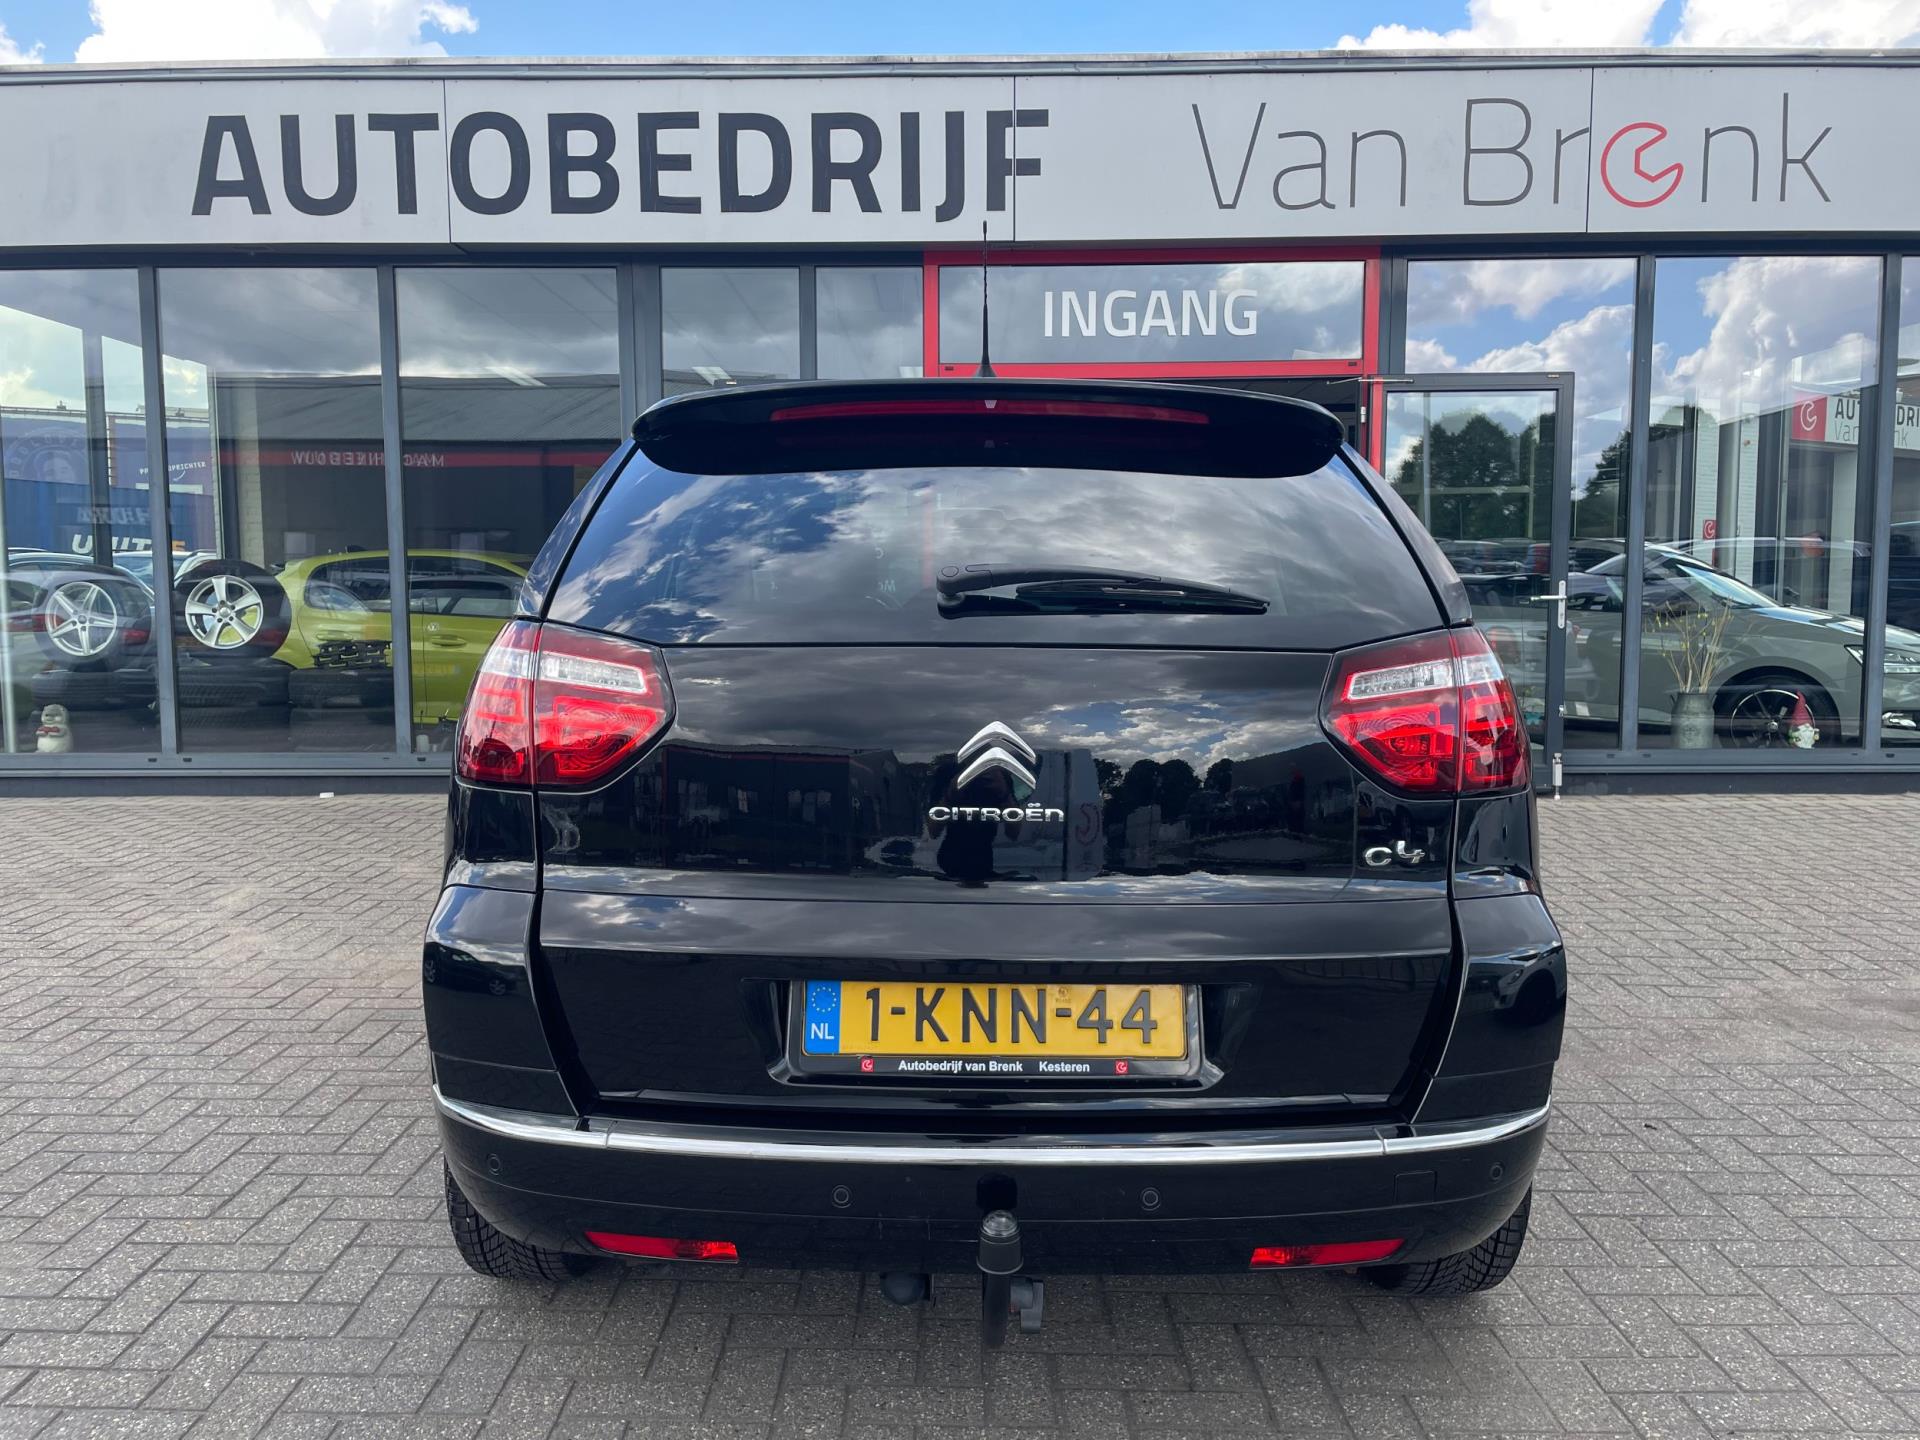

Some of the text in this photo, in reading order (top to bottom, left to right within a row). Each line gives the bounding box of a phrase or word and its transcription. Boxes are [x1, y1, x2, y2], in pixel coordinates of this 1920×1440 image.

[192, 109, 1049, 223] AUTOBEDRIJF
[1192, 102, 1407, 210] Van
[1044, 289, 1258, 337] INGANG
[928, 802, 1065, 822] CITROËN
[1365, 840, 1425, 866] C4
[865, 987, 1158, 1045] 1-KNN-44
[810, 1023, 835, 1040] NL
[898, 1060, 1090, 1073] Autobedrijf van Brenk Kesteren
